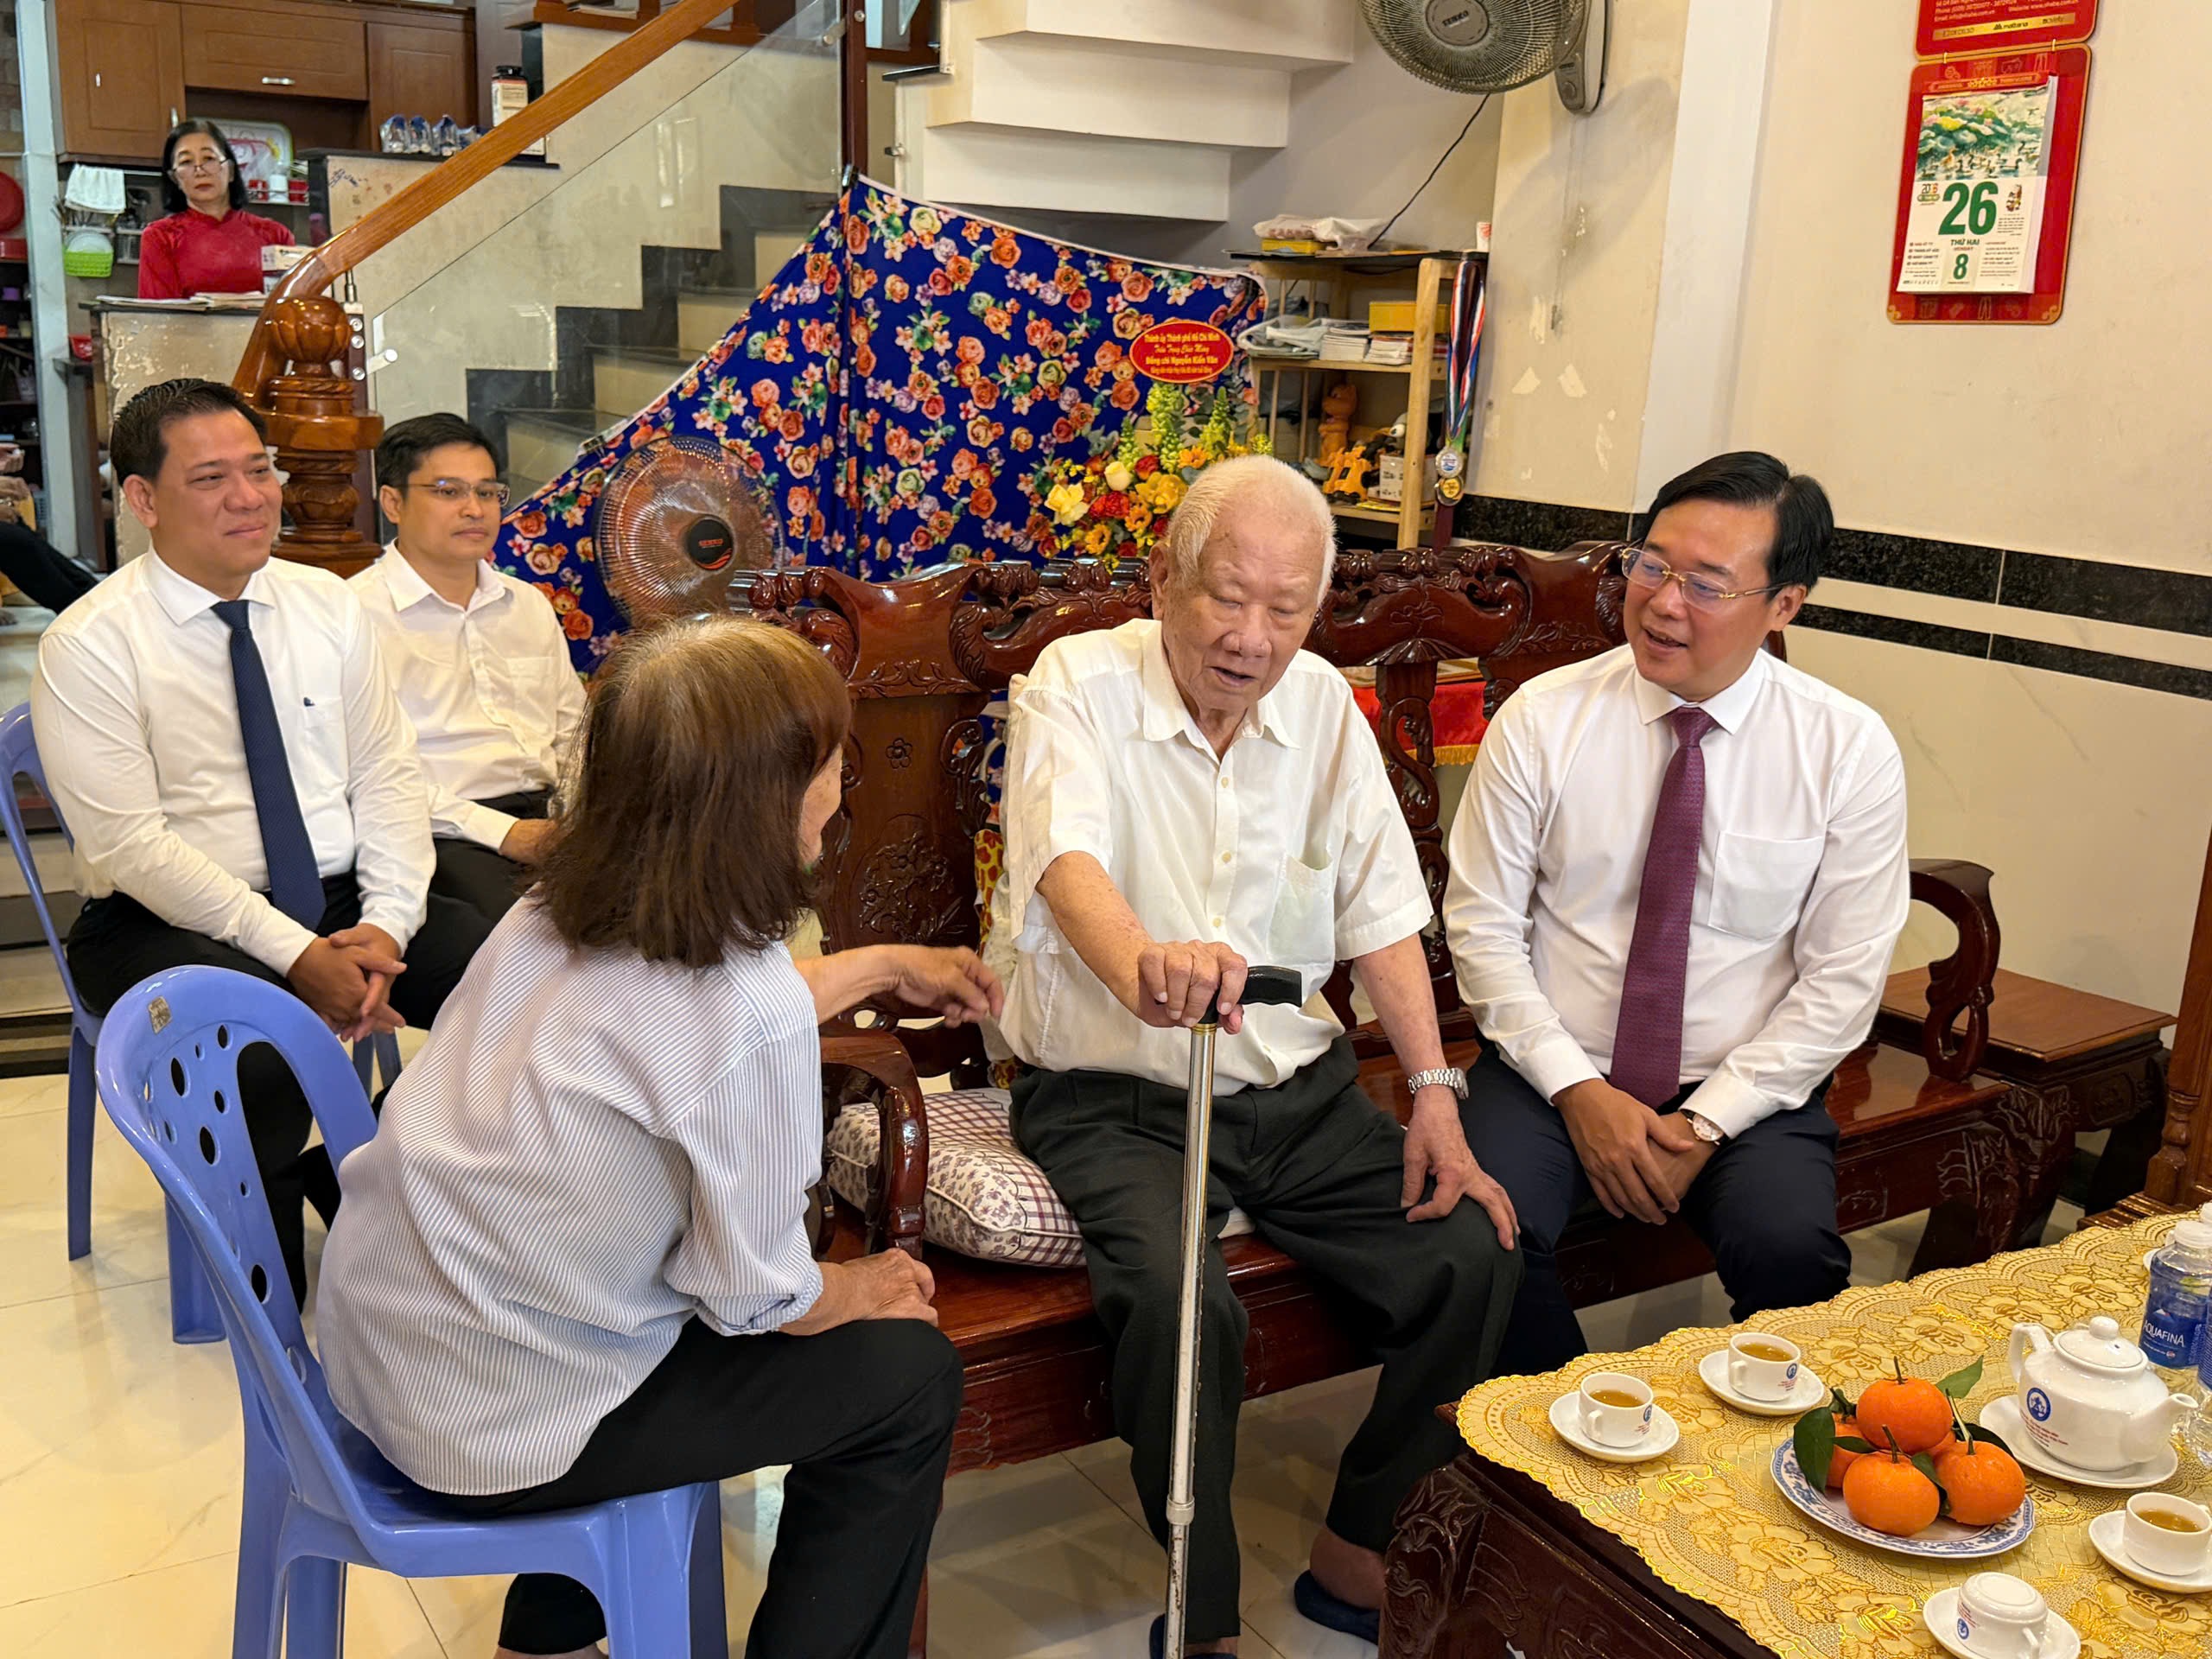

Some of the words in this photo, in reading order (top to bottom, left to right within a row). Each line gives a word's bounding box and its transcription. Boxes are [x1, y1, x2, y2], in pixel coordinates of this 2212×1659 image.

[1938, 181, 1999, 235] 26
[1953, 253, 1969, 280] 8
[2144, 1319, 2184, 1348] AQUAFINA
